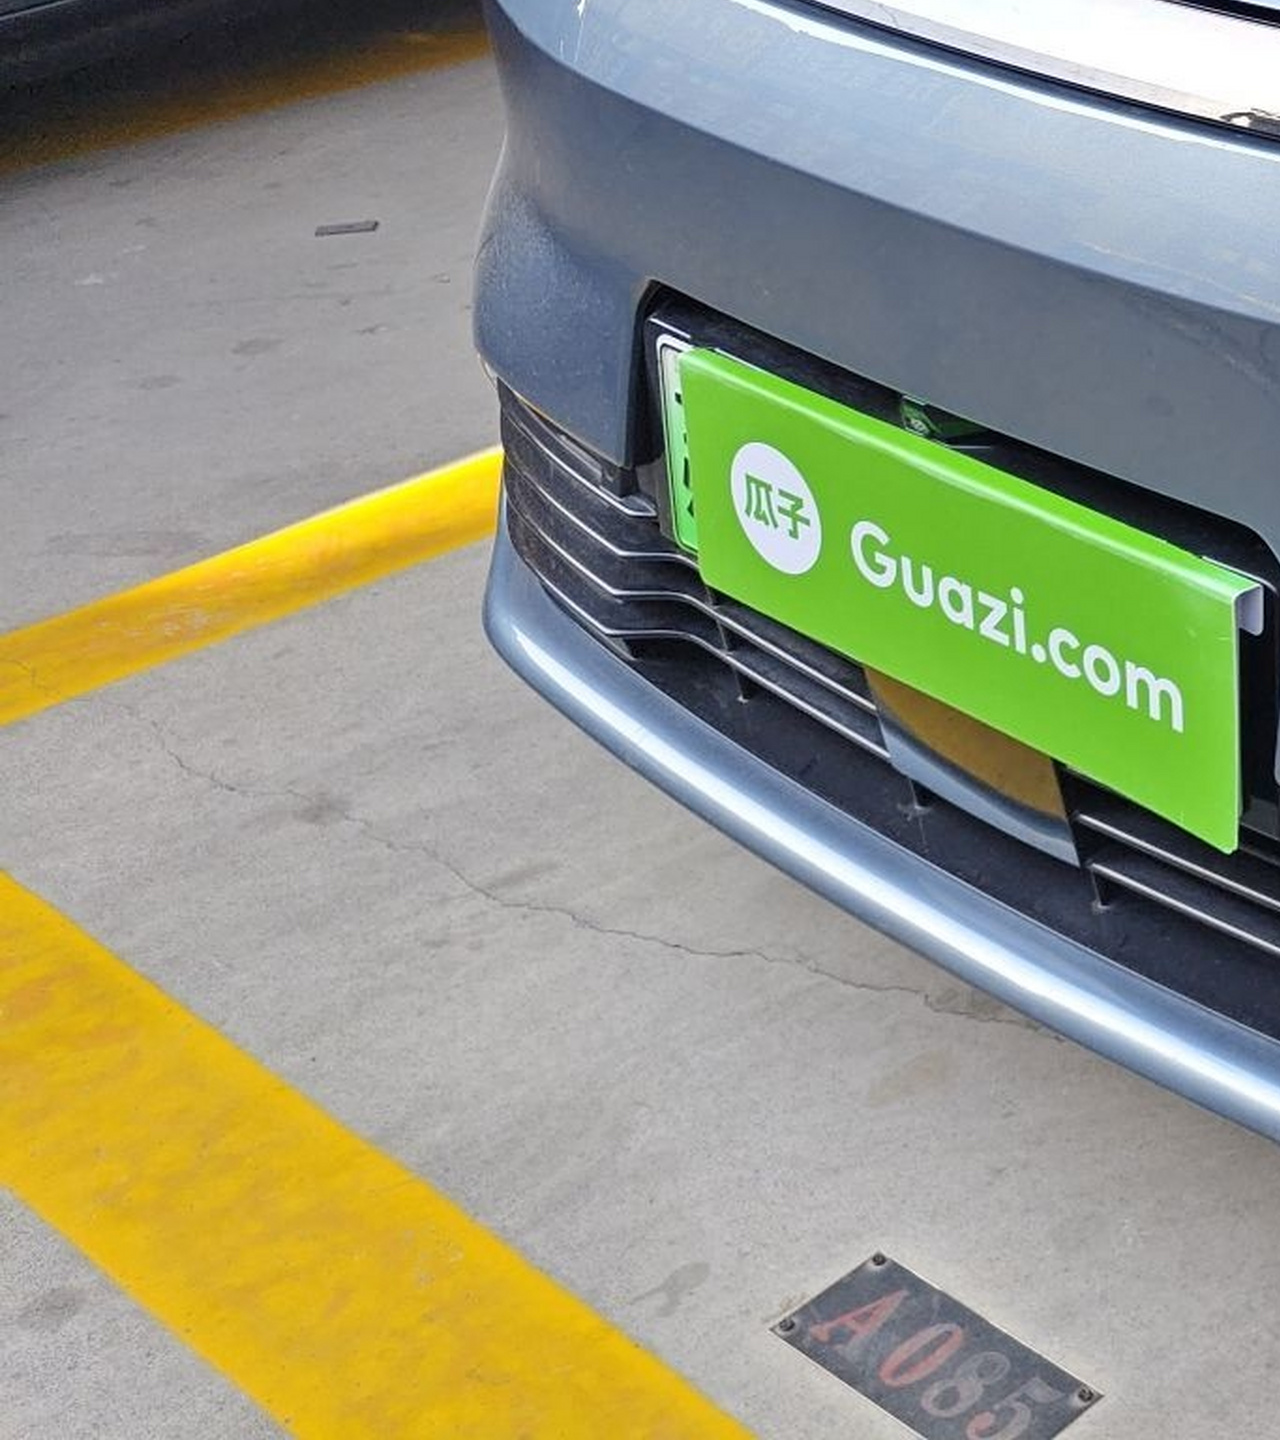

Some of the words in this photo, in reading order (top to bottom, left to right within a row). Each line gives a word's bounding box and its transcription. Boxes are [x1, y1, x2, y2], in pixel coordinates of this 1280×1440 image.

[744, 472, 811, 541] 瓜子
[849, 520, 1185, 735] Guazi.com
[808, 1287, 1067, 1440] A085
